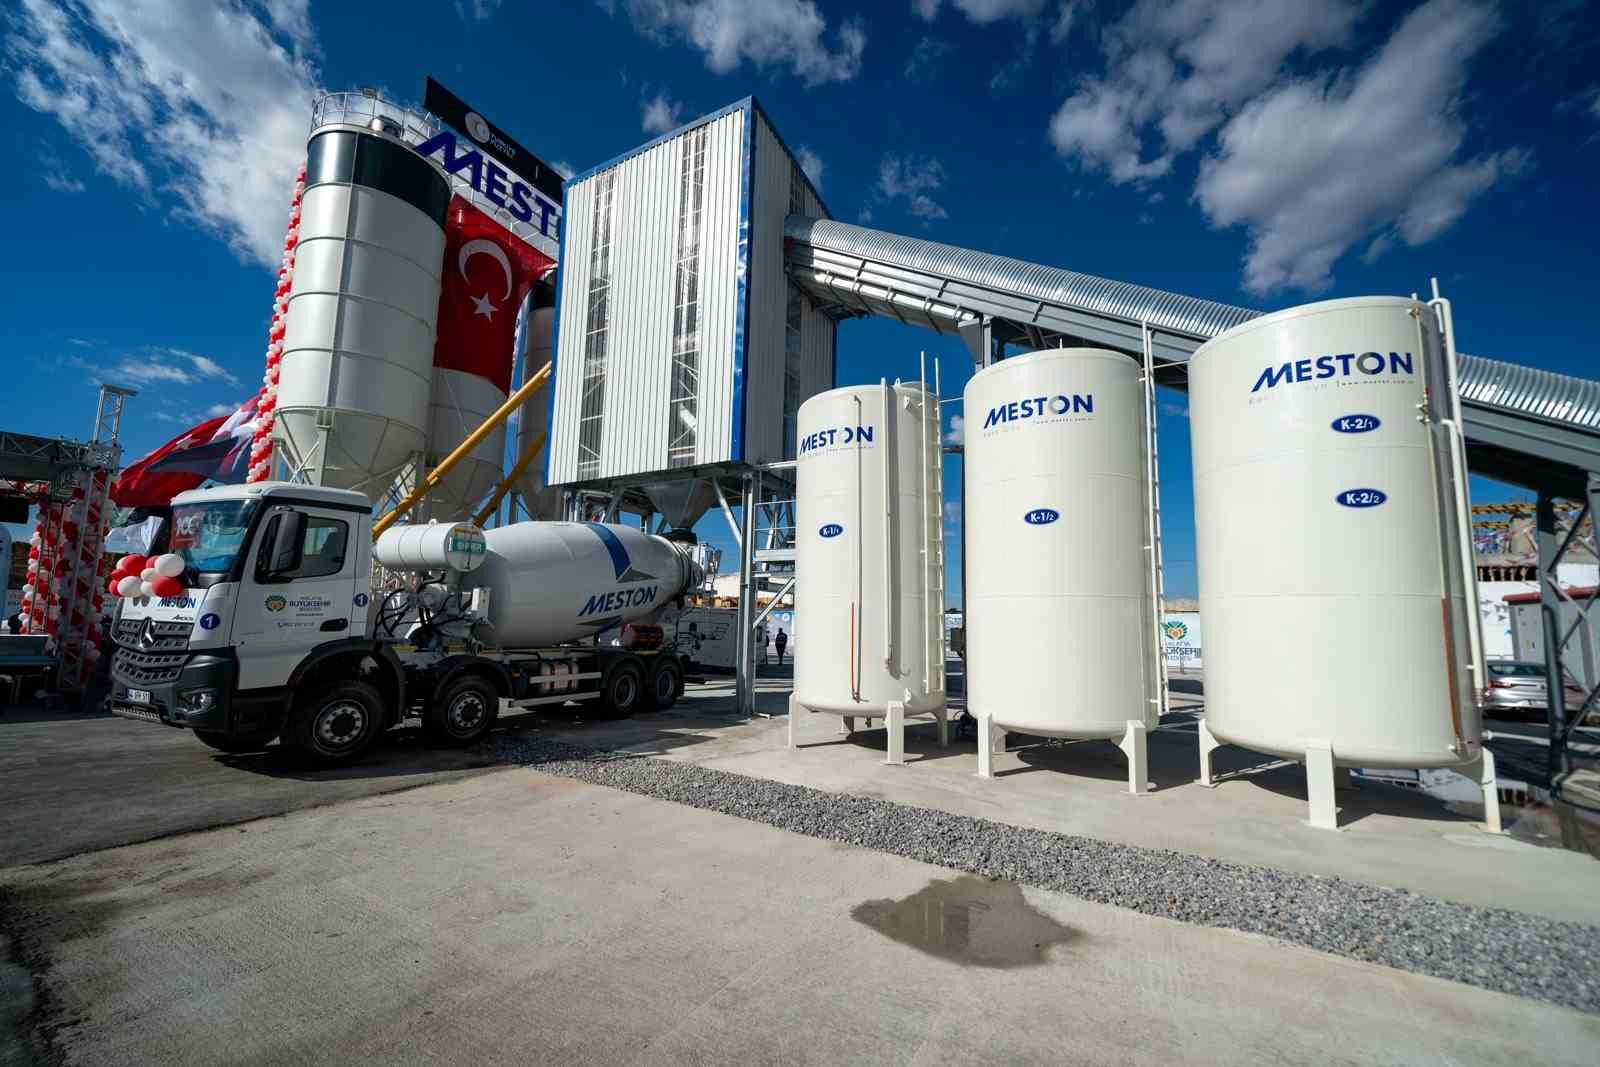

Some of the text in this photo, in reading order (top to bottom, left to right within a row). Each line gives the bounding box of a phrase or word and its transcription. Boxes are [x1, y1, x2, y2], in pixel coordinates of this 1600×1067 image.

[416, 131, 561, 238] MEST
[1251, 352, 1413, 392] MESTON
[983, 394, 1094, 429] MESTON
[1341, 418, 1373, 430] K-2/1
[799, 426, 873, 455] MESTON
[1346, 493, 1380, 504] K-2/2
[1030, 511, 1054, 522] K-1/2
[579, 585, 657, 616] MESTON
